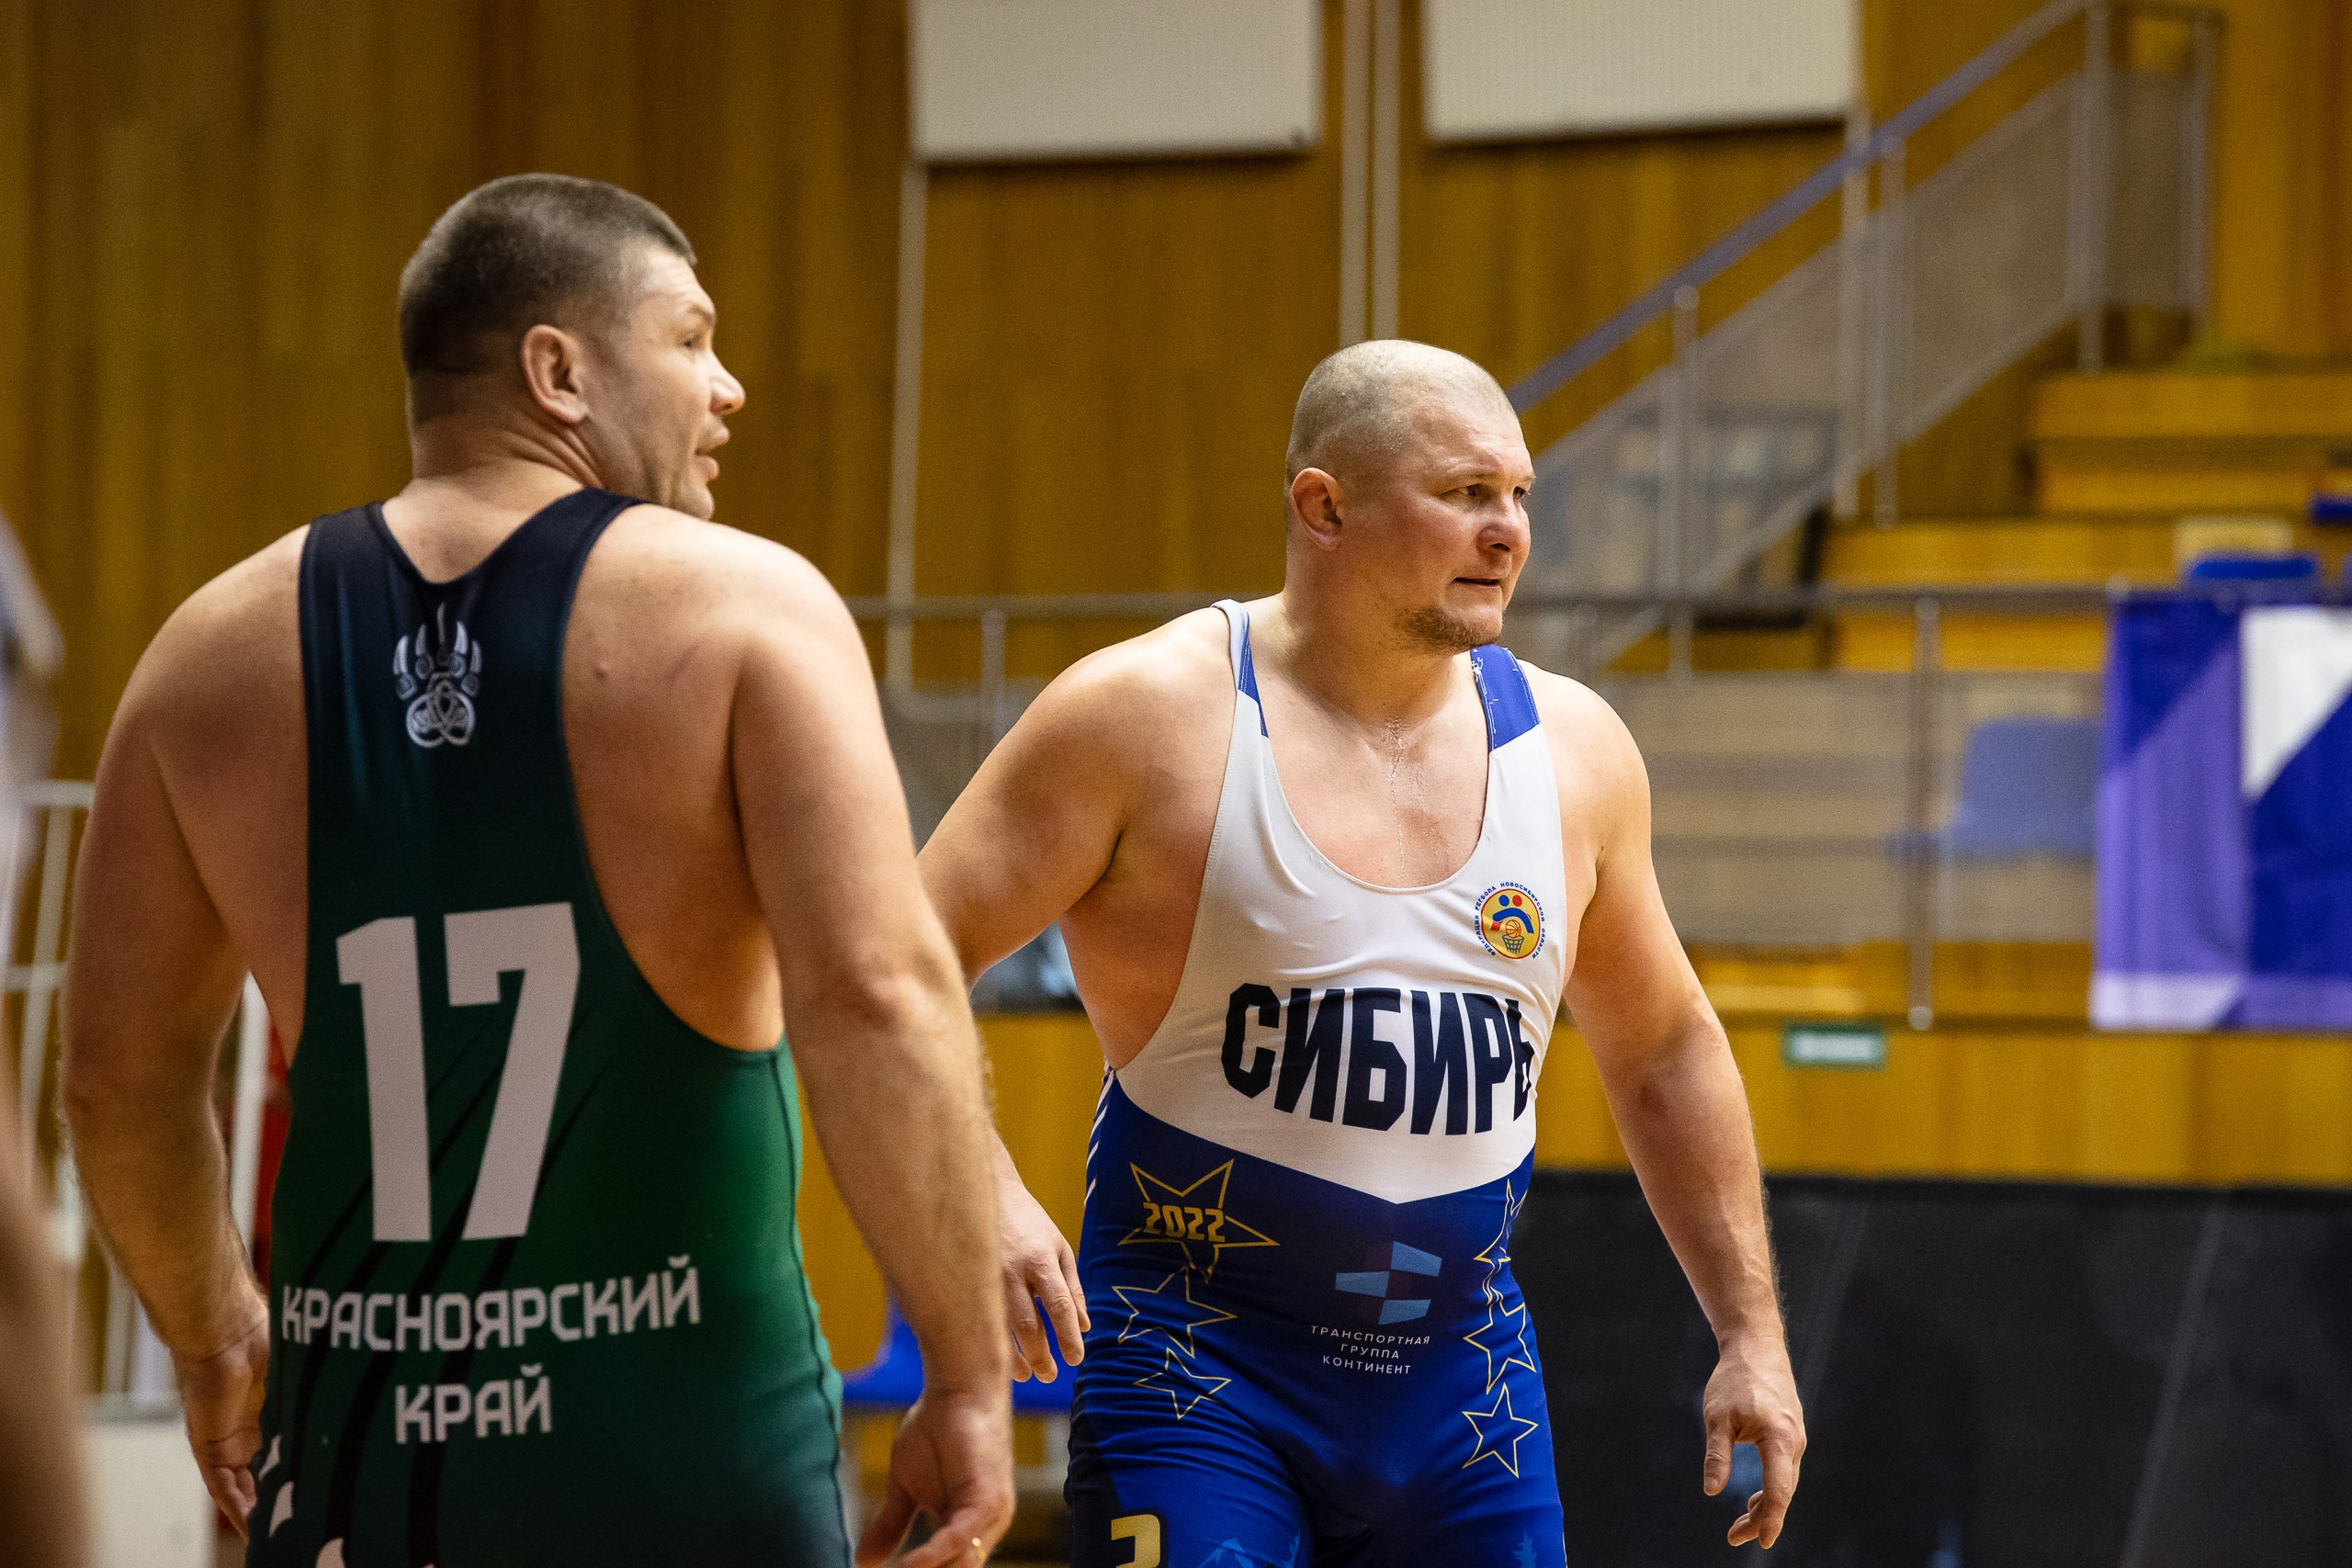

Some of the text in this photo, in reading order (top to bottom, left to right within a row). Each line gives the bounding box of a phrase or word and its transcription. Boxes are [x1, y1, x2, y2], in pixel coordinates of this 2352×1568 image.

[336, 902, 581, 1241] 17
[1142, 1201, 1226, 1243] 2022
[281, 1254, 701, 1352] КРАСНОЯРСКИЙ
[1310, 1325, 1430, 1345] ТРАНСПОРТНАЯ
[1340, 1343, 1399, 1359] ГРУППА
[1322, 1355, 1411, 1375] КОНТИНЕНТ
[395, 1363, 552, 1445] КРАЙ
